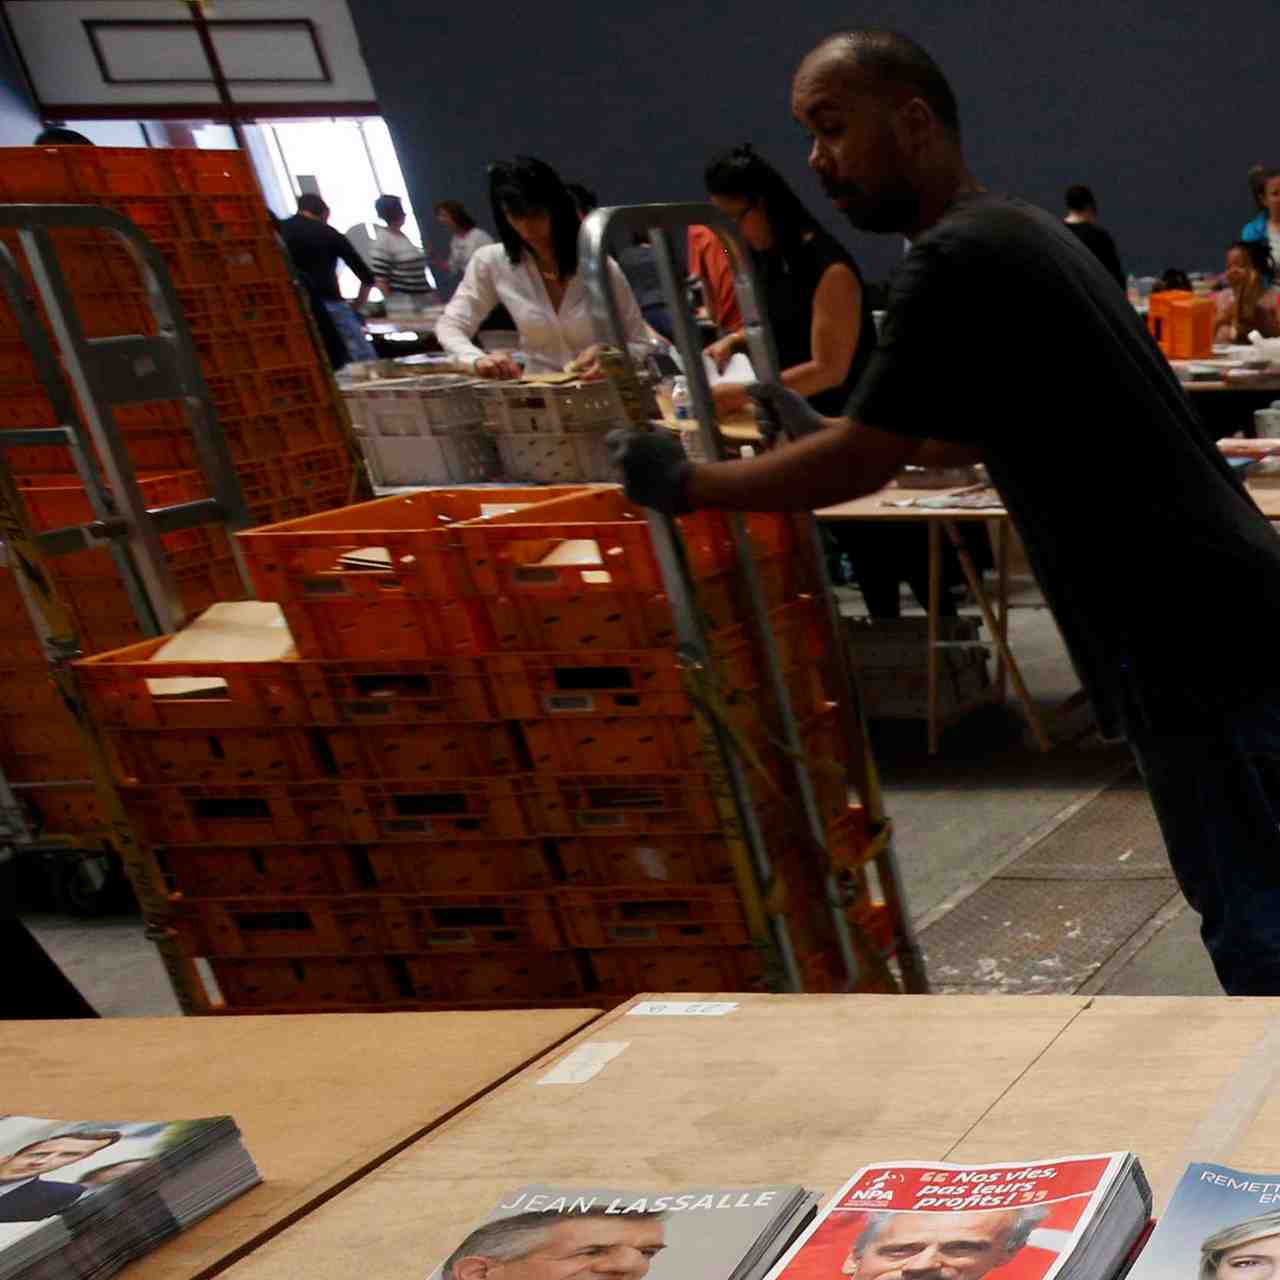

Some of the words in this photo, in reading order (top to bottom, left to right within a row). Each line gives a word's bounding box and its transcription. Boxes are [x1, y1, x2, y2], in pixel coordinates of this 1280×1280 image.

[952, 1171, 1004, 1183] Nos
[1006, 1167, 1058, 1180] vies,
[852, 1190, 894, 1201] NPA
[914, 1183, 972, 1196] pas
[972, 1181, 1036, 1195] leurs
[501, 1193, 597, 1213] JEAN
[604, 1191, 777, 1215] LASSALLE
